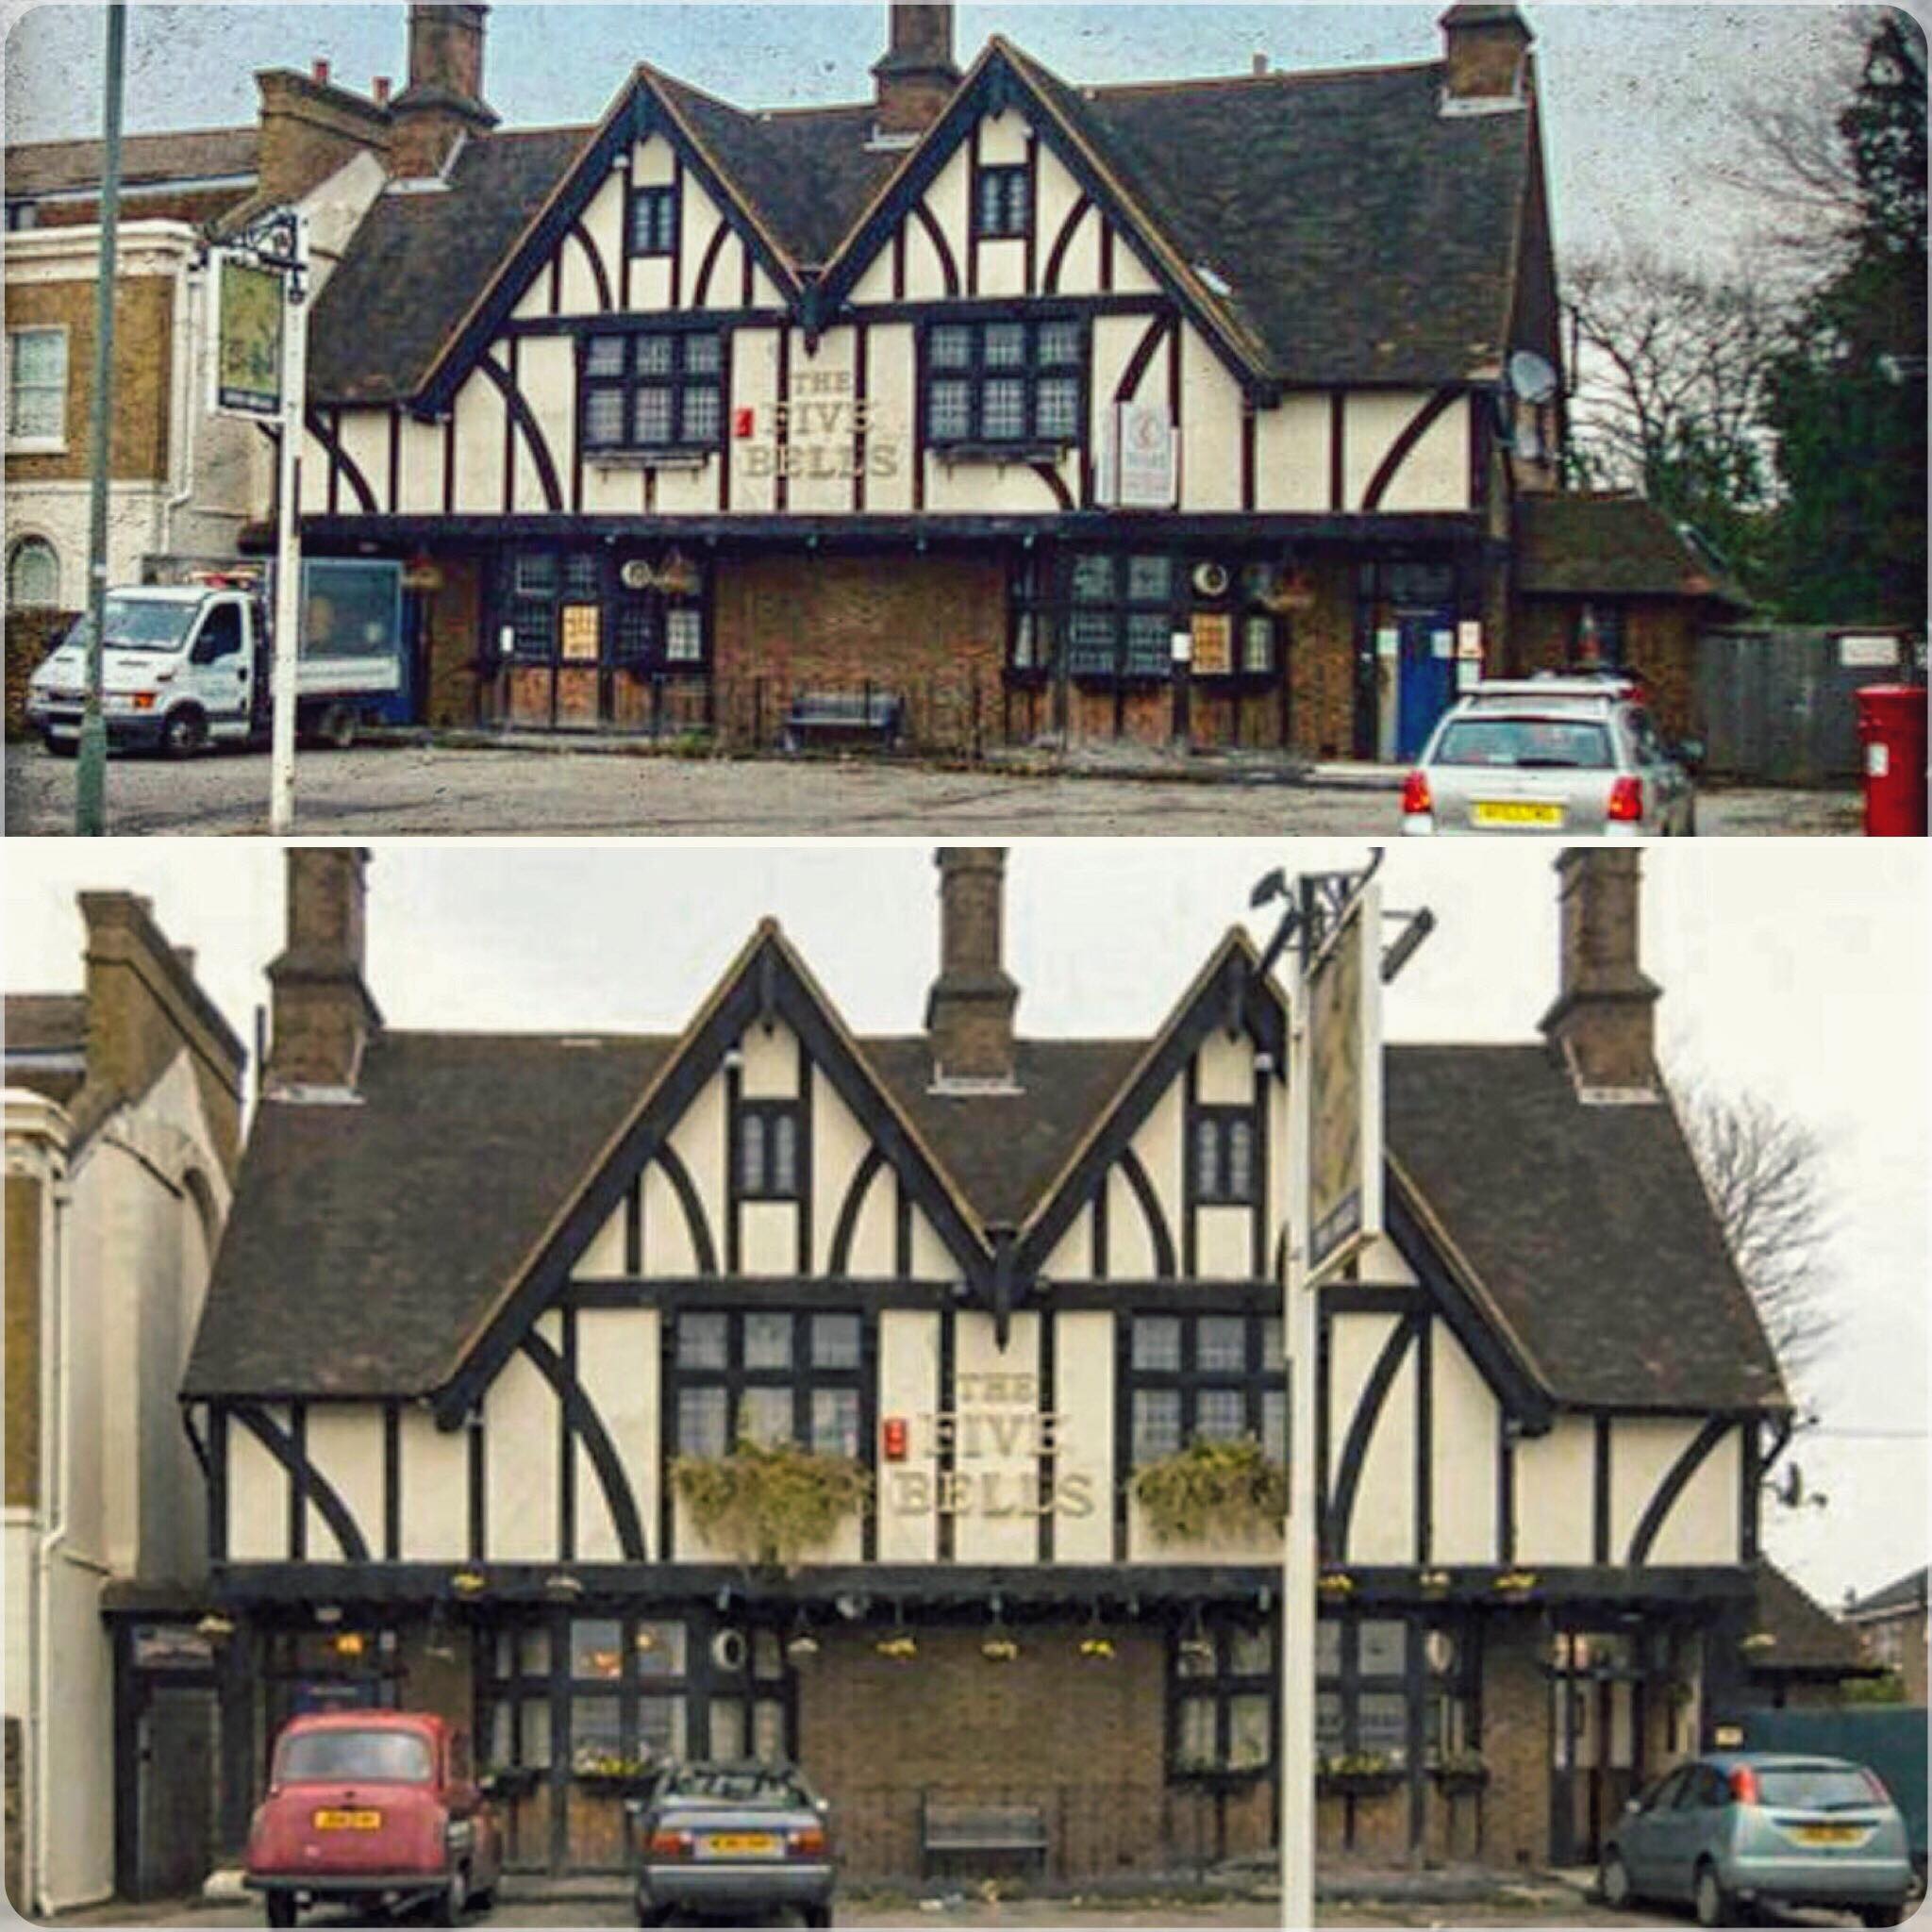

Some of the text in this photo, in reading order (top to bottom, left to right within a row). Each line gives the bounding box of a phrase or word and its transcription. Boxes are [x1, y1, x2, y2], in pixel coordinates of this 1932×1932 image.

[793, 372, 851, 393] THE
[741, 445, 897, 480] BELLS
[893, 1473, 1093, 1519] BELLS
